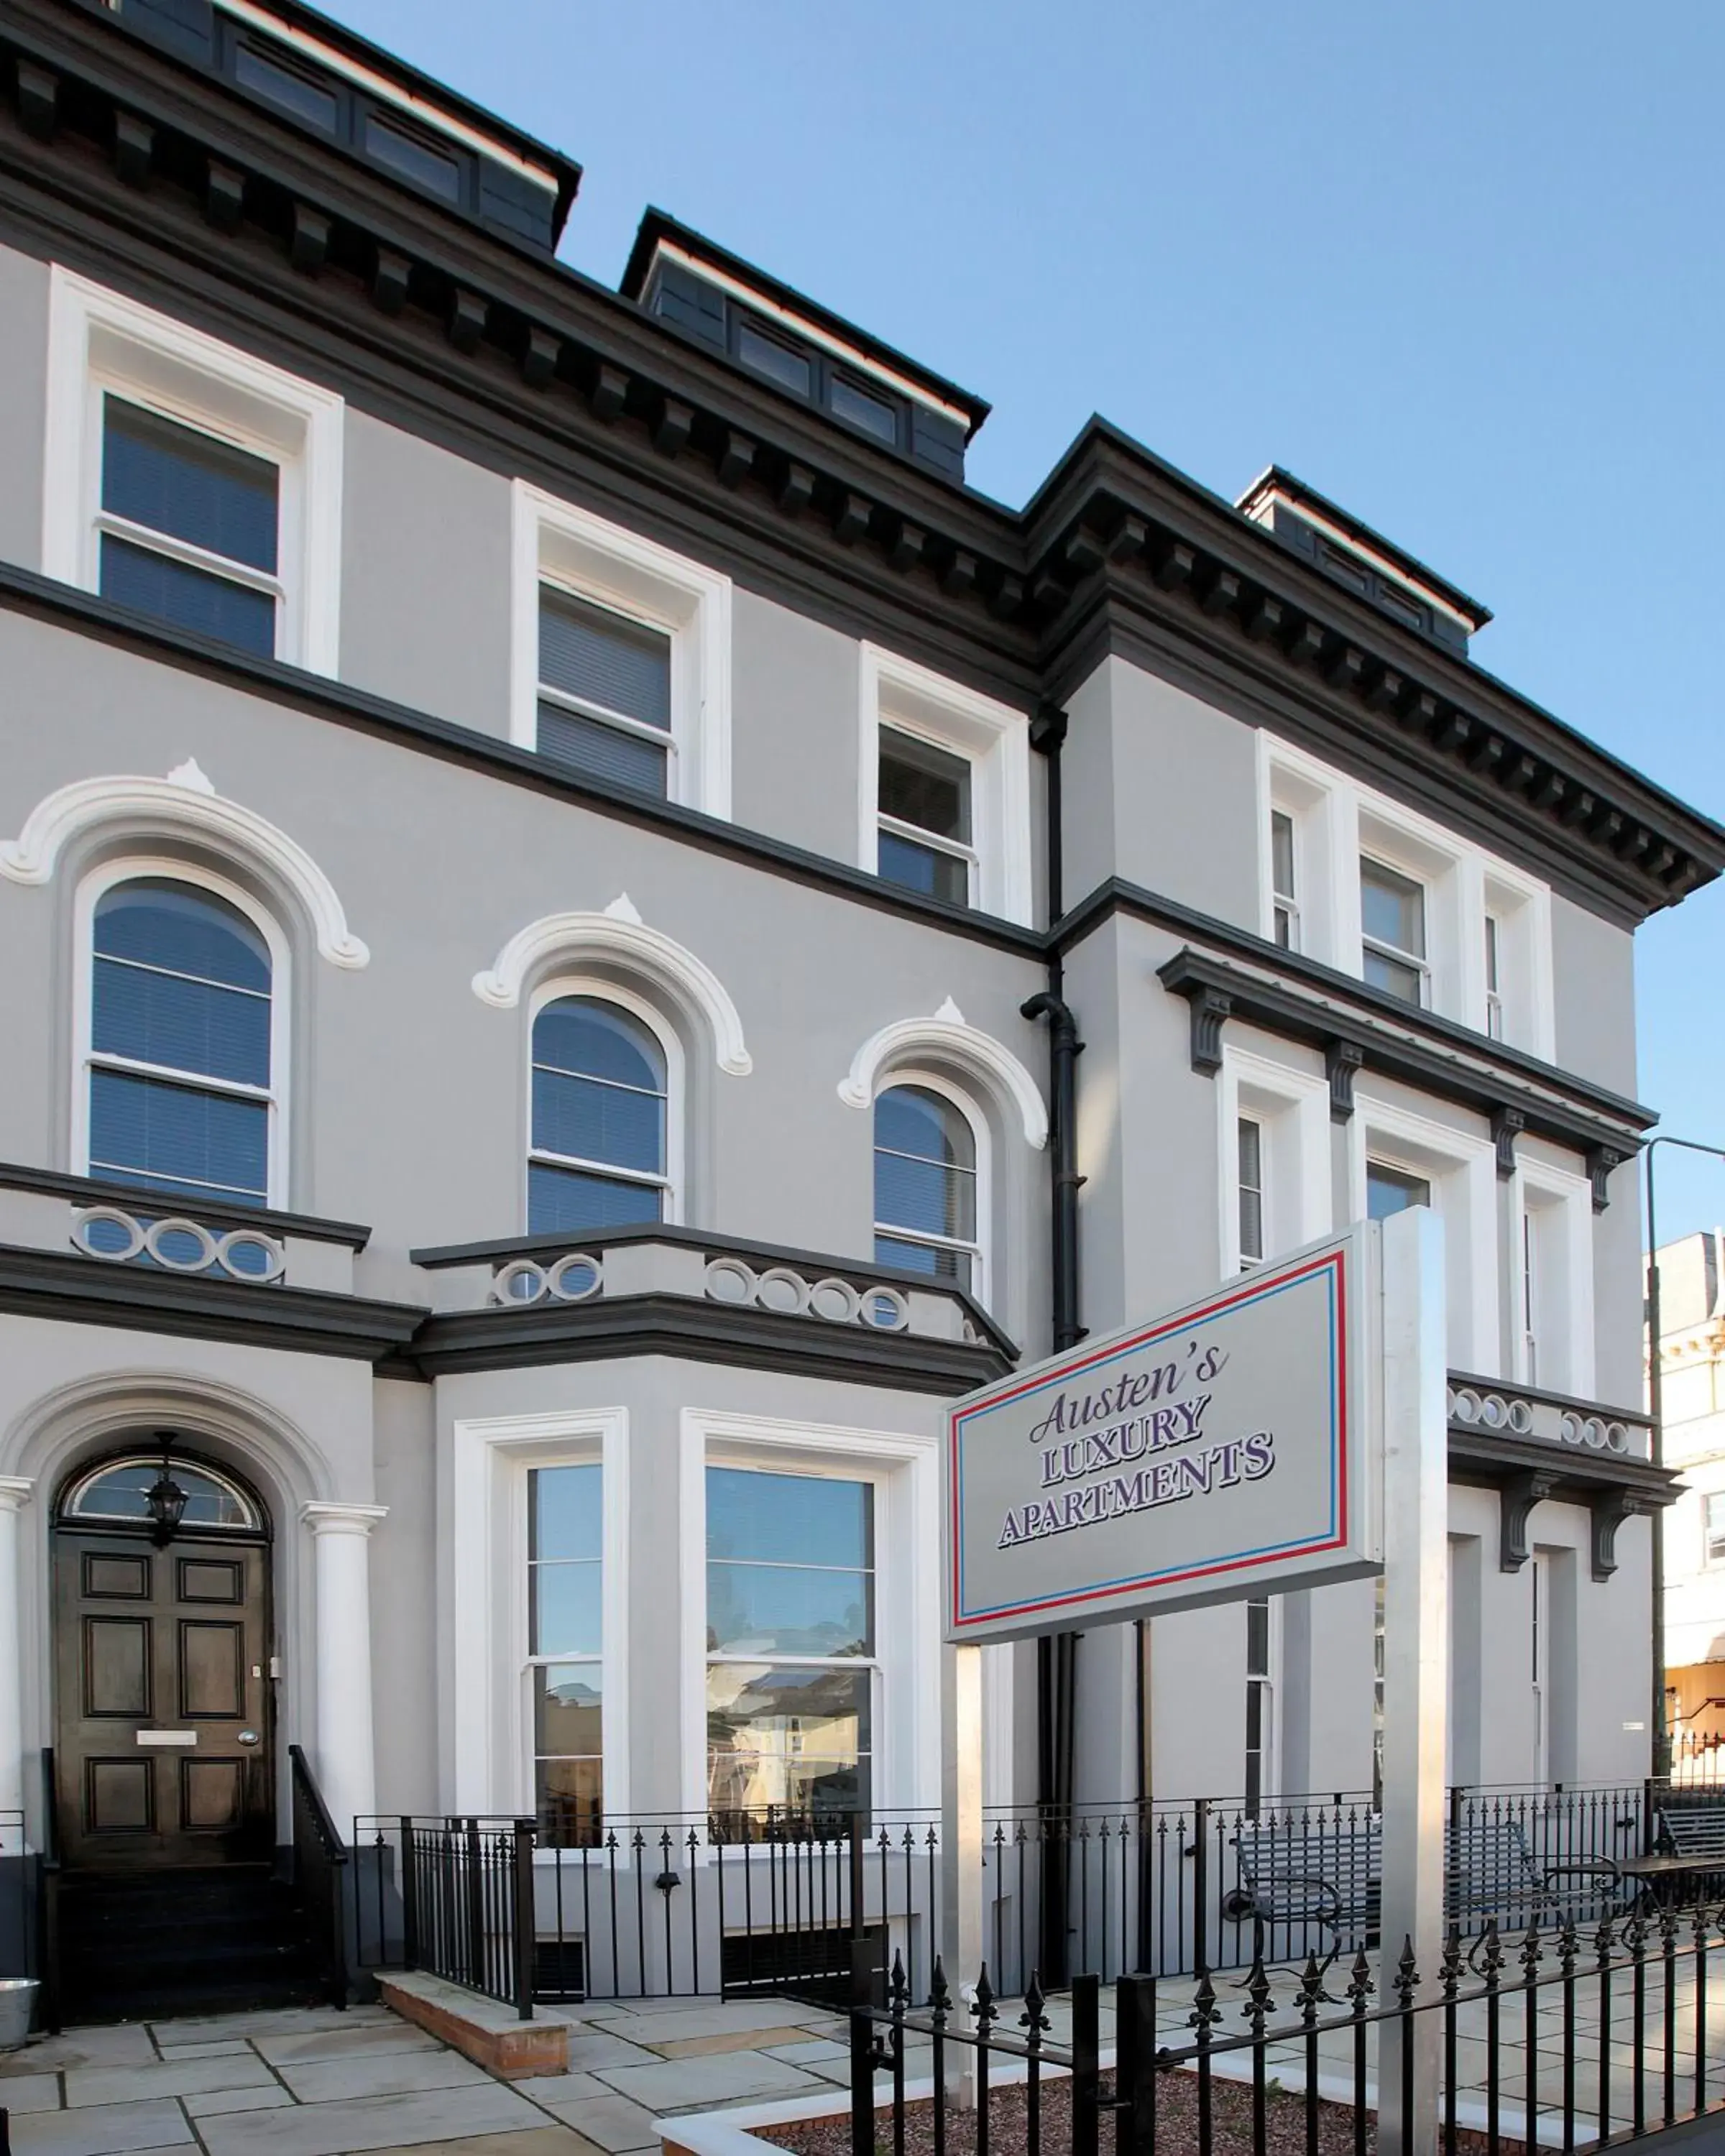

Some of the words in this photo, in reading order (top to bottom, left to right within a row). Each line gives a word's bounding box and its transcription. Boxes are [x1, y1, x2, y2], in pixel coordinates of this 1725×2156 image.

[1030, 1341, 1230, 1443] Austen's
[1041, 1395, 1211, 1487] LUXURY
[997, 1432, 1276, 1548] APARTMENTS
